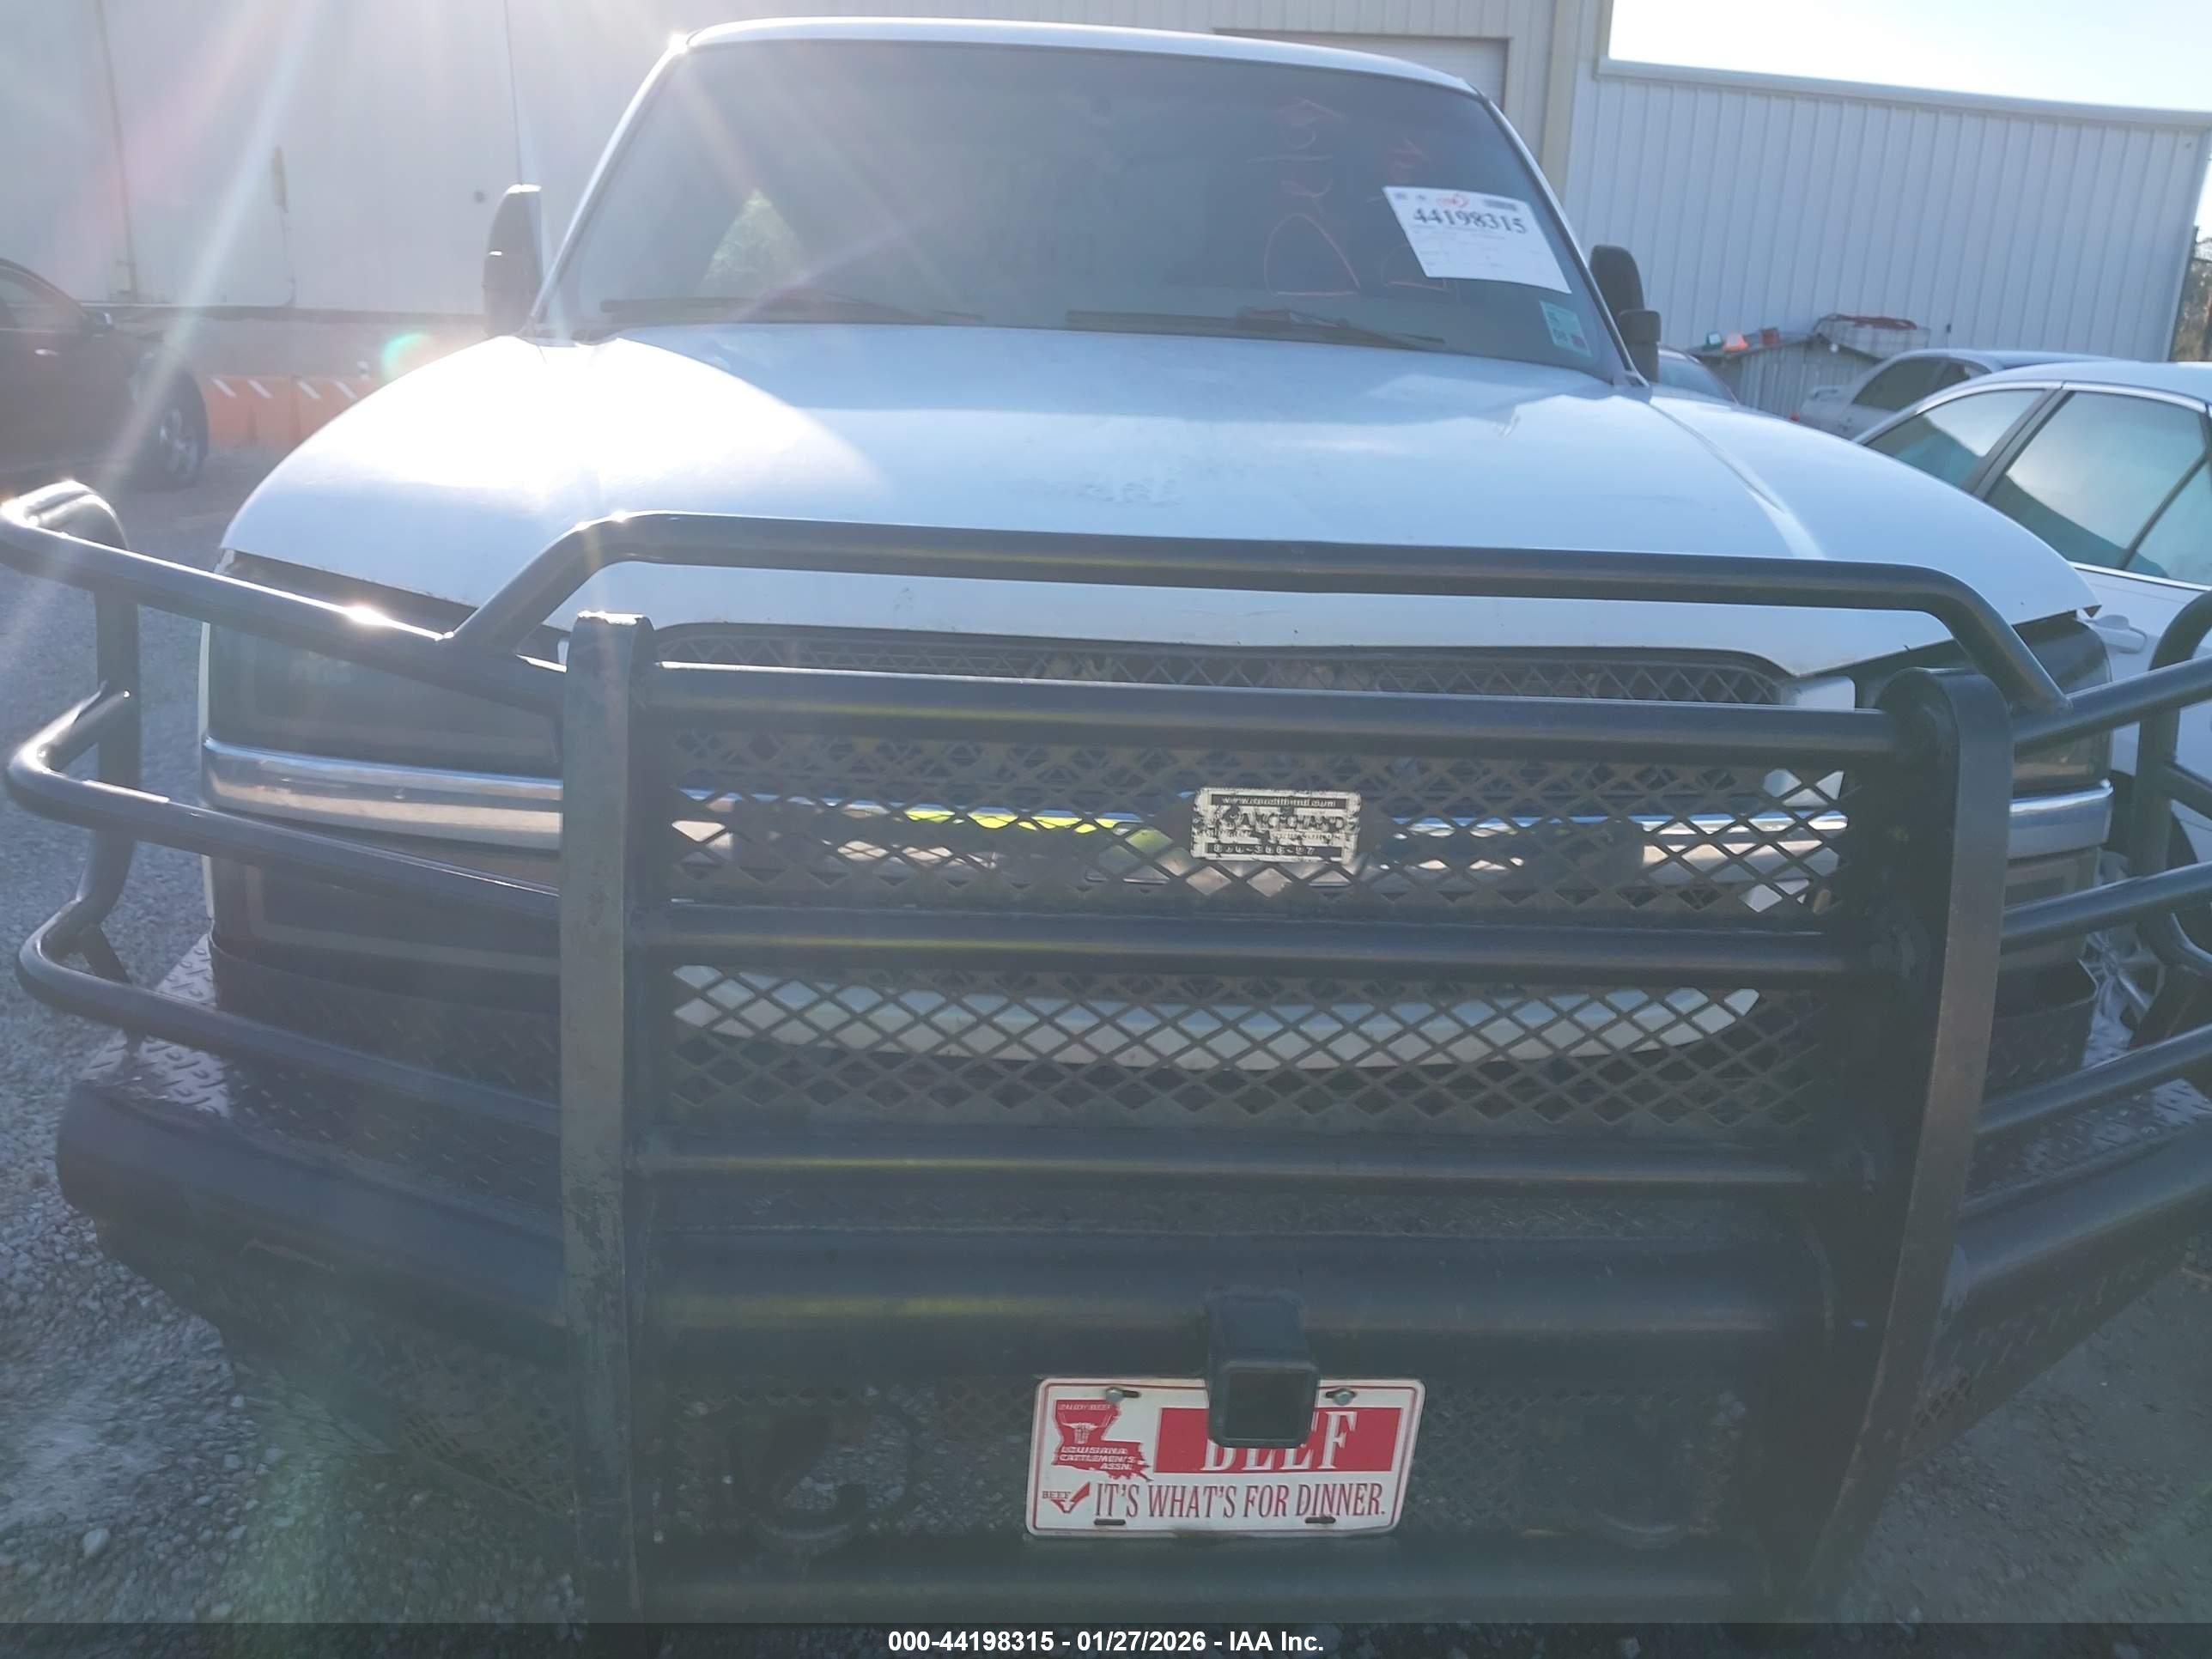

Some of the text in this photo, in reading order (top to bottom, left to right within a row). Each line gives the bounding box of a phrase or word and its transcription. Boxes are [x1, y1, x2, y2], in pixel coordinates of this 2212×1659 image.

[1413, 208, 1528, 234] 44198315
[1060, 1446, 1128, 1455] LOUISIANA
[1059, 1454, 1137, 1463] CATTLEMEN'S
[1042, 1490, 1072, 1499] BEEF
[1096, 1482, 1386, 1518] IT'S WHAT'S FOR DINNER.
